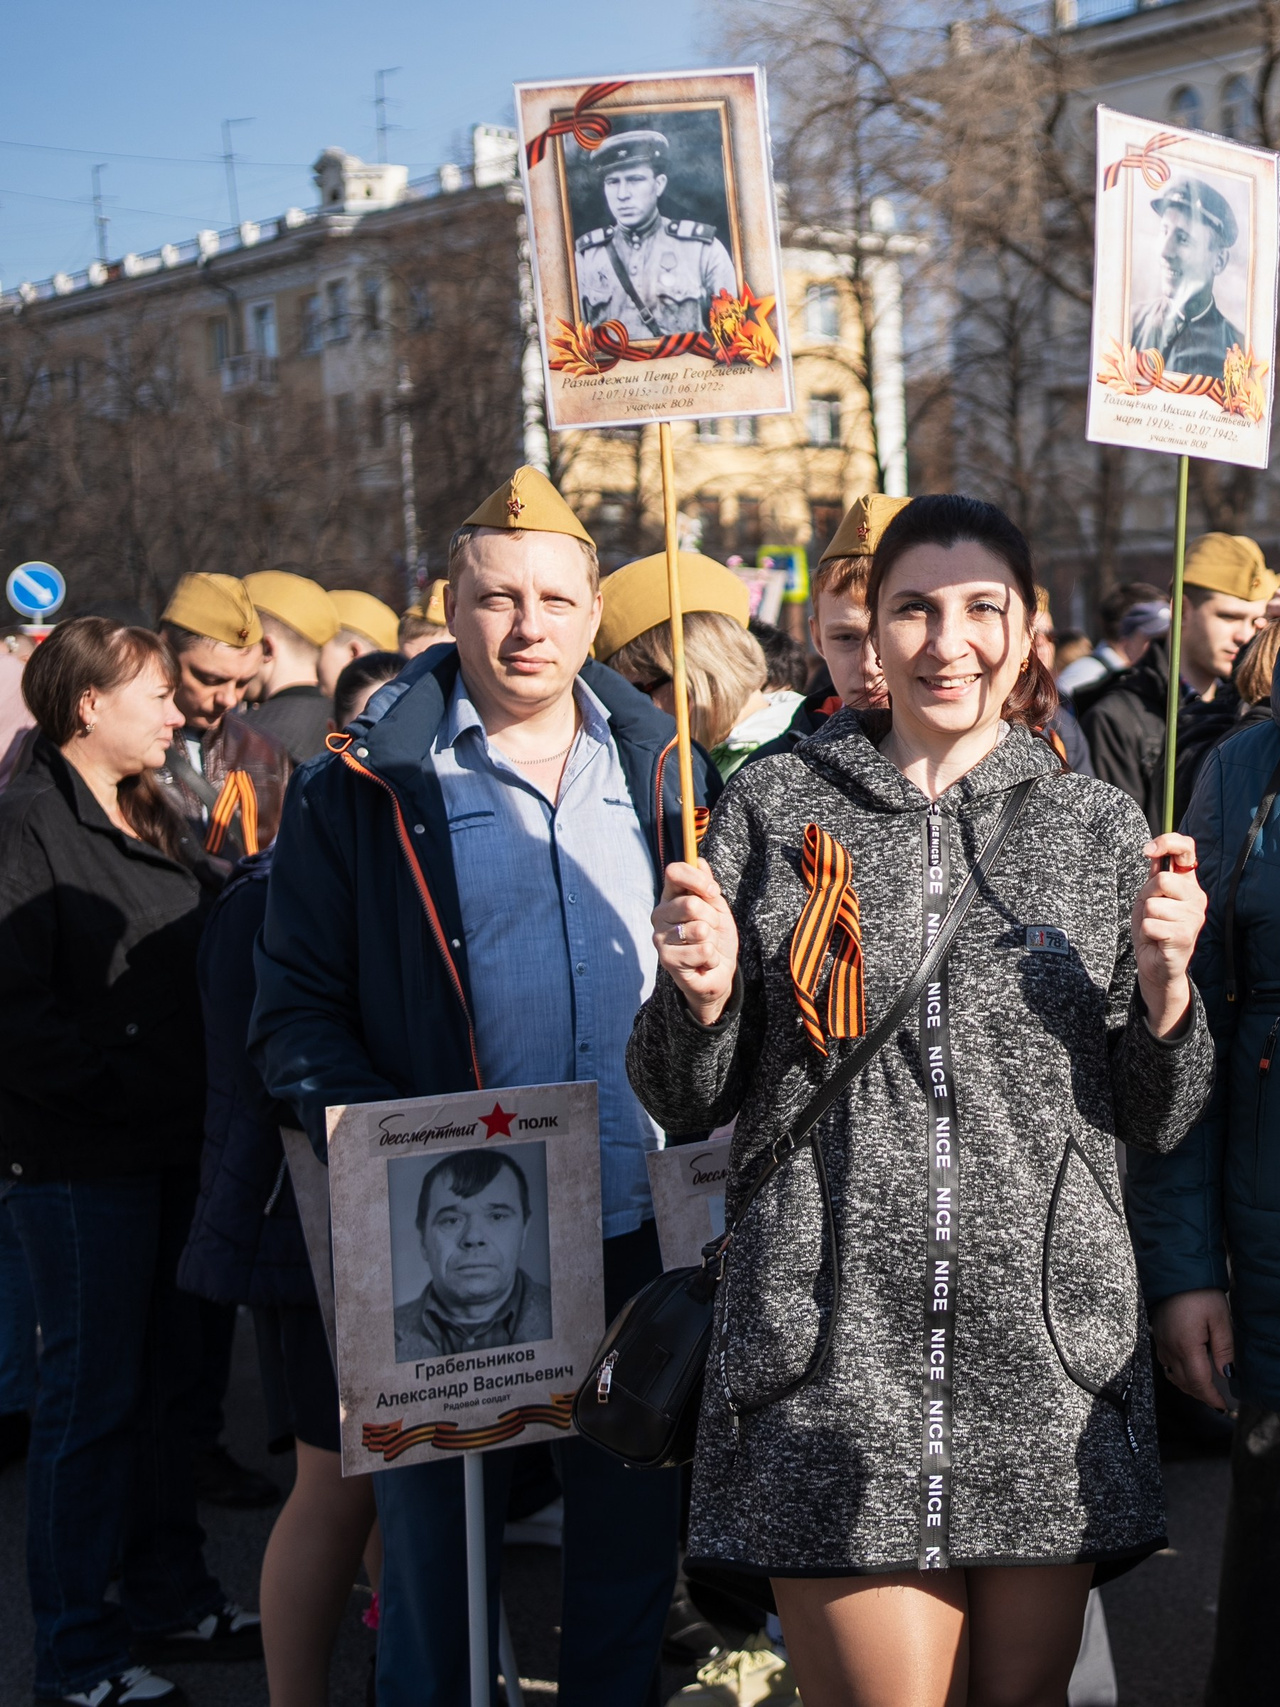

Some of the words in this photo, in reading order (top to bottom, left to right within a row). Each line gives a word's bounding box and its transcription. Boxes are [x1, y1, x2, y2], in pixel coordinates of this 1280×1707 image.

[643, 369, 680, 385] Петр
[682, 363, 755, 381] Георгиевич
[670, 397, 695, 409] ВОВ
[1113, 413, 1143, 427] март
[1160, 402, 1197, 418] Михаил
[1198, 409, 1252, 429] Игнатьевич
[1148, 434, 1190, 449] участник
[1190, 439, 1209, 449] ВОВ
[929, 865, 944, 895] CE
[927, 982, 942, 1029] NICE
[928, 1045, 948, 1098] NICE
[378, 1113, 479, 1146] бессмертный
[935, 1116, 951, 1169] NICE
[936, 1187, 952, 1241] NICE
[934, 1260, 950, 1312] NICE
[415, 1348, 535, 1382] Грабельников
[931, 1328, 946, 1381] NICE
[376, 1380, 468, 1409] Александр
[473, 1364, 574, 1392] Васильевич
[443, 1398, 480, 1412] Рядовой
[482, 1393, 511, 1406] солдат
[929, 1400, 944, 1456] NICE
[926, 1475, 943, 1528] NICE
